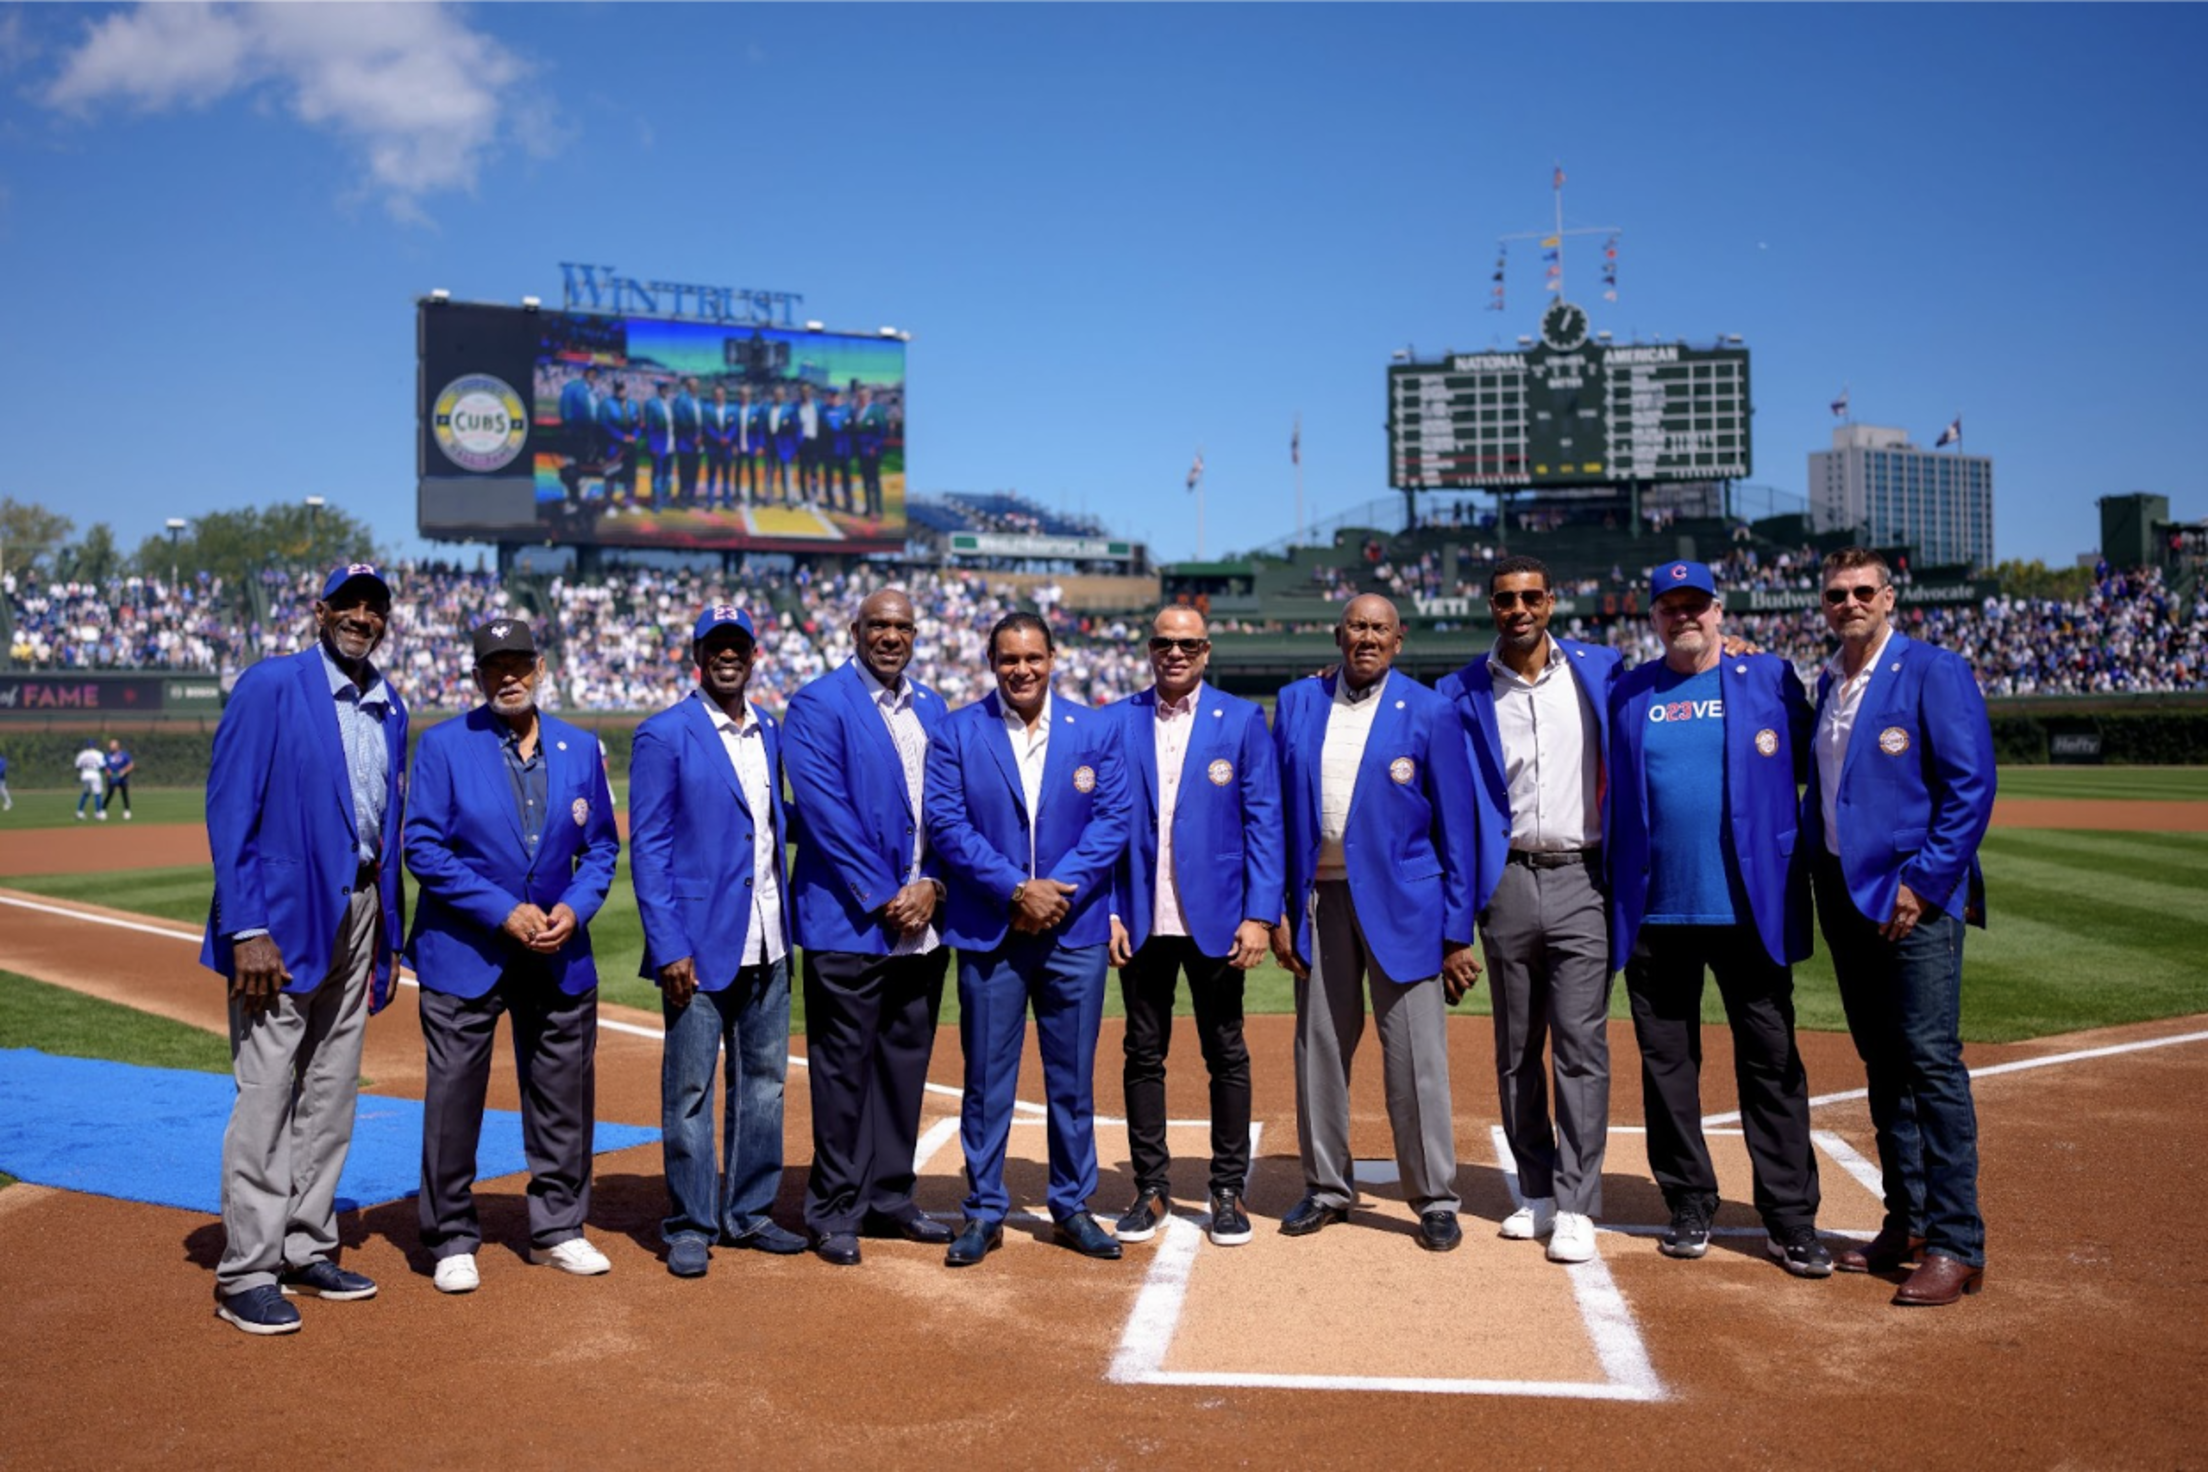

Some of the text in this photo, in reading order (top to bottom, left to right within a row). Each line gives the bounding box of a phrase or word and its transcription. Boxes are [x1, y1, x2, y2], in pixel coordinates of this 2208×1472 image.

[558, 262, 803, 326] WINTRUST
[1454, 354, 1528, 371] NATIONAL
[1603, 347, 1678, 364] AMERICAN
[455, 411, 506, 435] CUBS
[1670, 564, 1687, 580] C
[1750, 590, 1820, 609] Budwe
[1902, 584, 1975, 601] Advocate
[1415, 597, 1469, 615] YETI
[23, 684, 98, 708] FAME
[1649, 700, 1725, 722] O23VE
